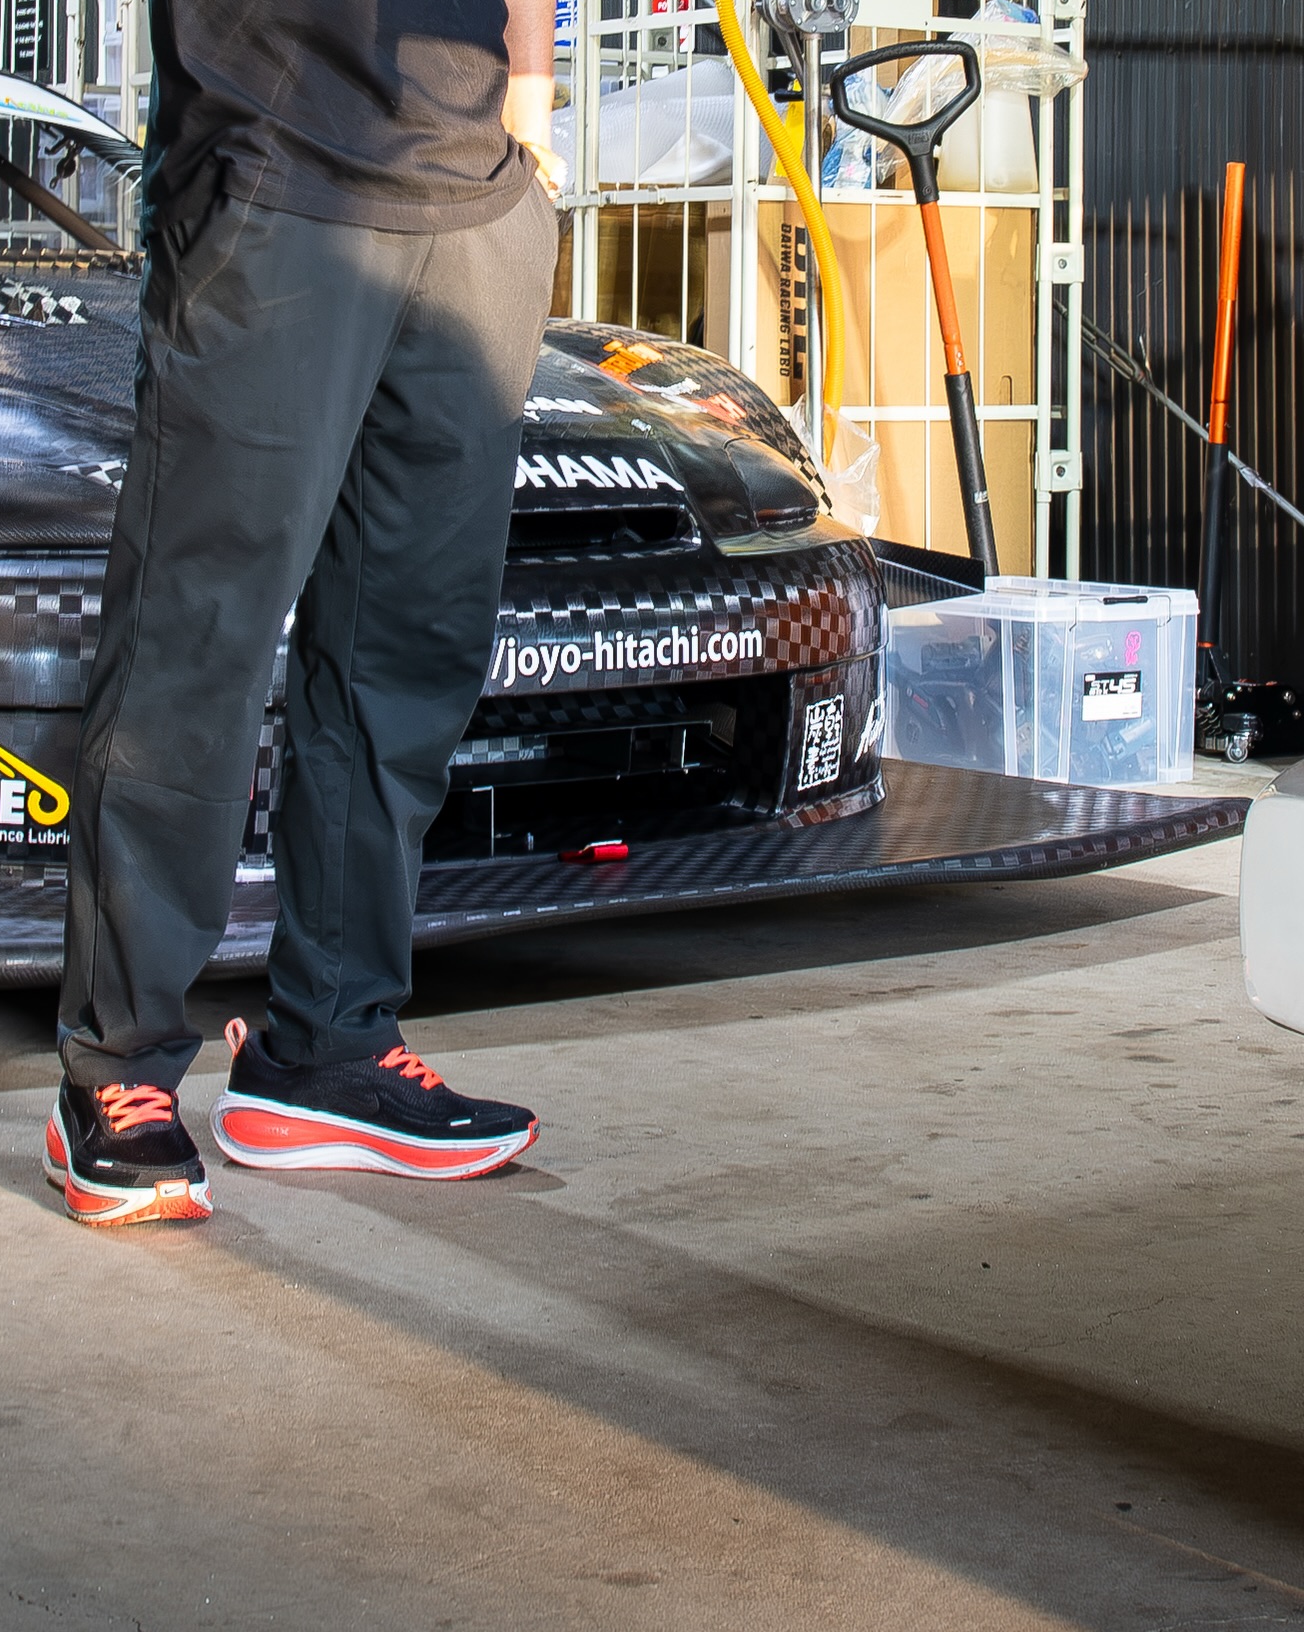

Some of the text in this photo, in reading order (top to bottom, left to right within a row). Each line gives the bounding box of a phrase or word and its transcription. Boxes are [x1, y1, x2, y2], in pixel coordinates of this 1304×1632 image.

[779, 222, 792, 378] DAIWA RACING LABO
[27, 827, 71, 845] Lubri
